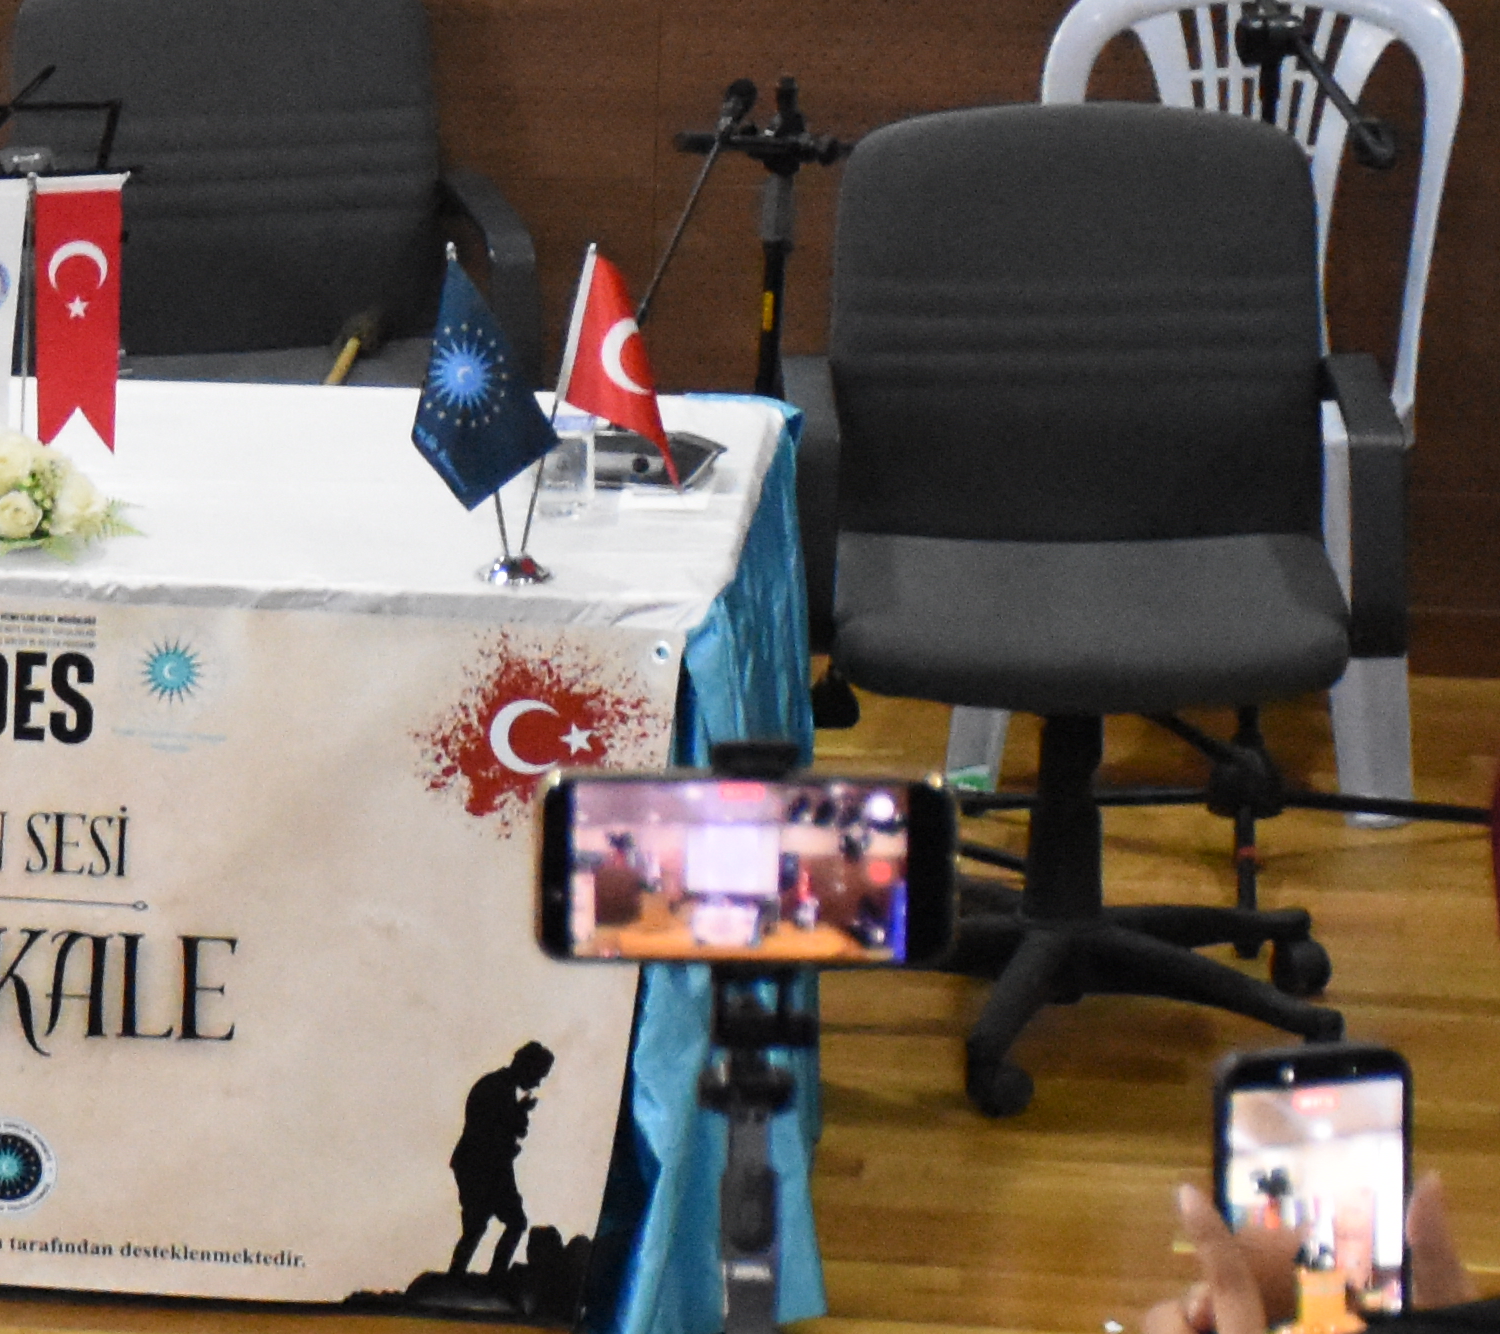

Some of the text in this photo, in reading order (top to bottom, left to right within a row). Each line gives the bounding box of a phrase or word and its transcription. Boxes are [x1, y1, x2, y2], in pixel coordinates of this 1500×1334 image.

[24, 805, 132, 878] SESİ
[9, 1236, 114, 1257] tarafından
[119, 1240, 307, 1269] desteklenmektedir.
